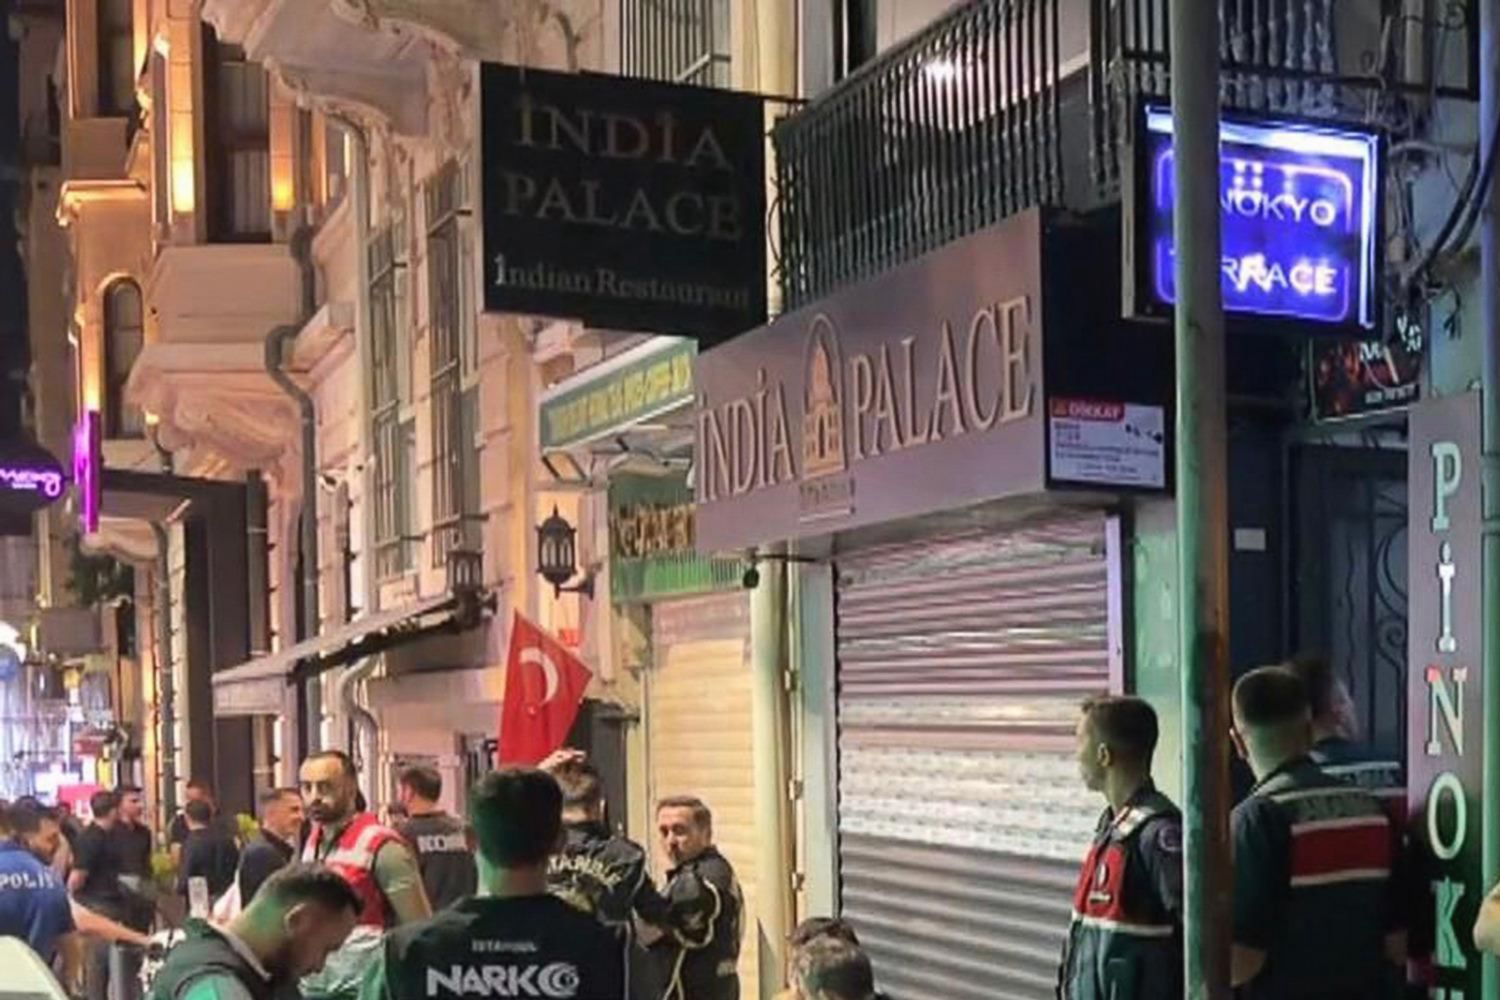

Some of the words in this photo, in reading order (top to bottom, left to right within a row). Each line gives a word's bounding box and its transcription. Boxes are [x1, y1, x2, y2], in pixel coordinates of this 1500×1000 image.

[502, 170, 742, 242] PALACE
[1220, 188, 1337, 226] NOKYO
[850, 295, 1036, 461] PALACE
